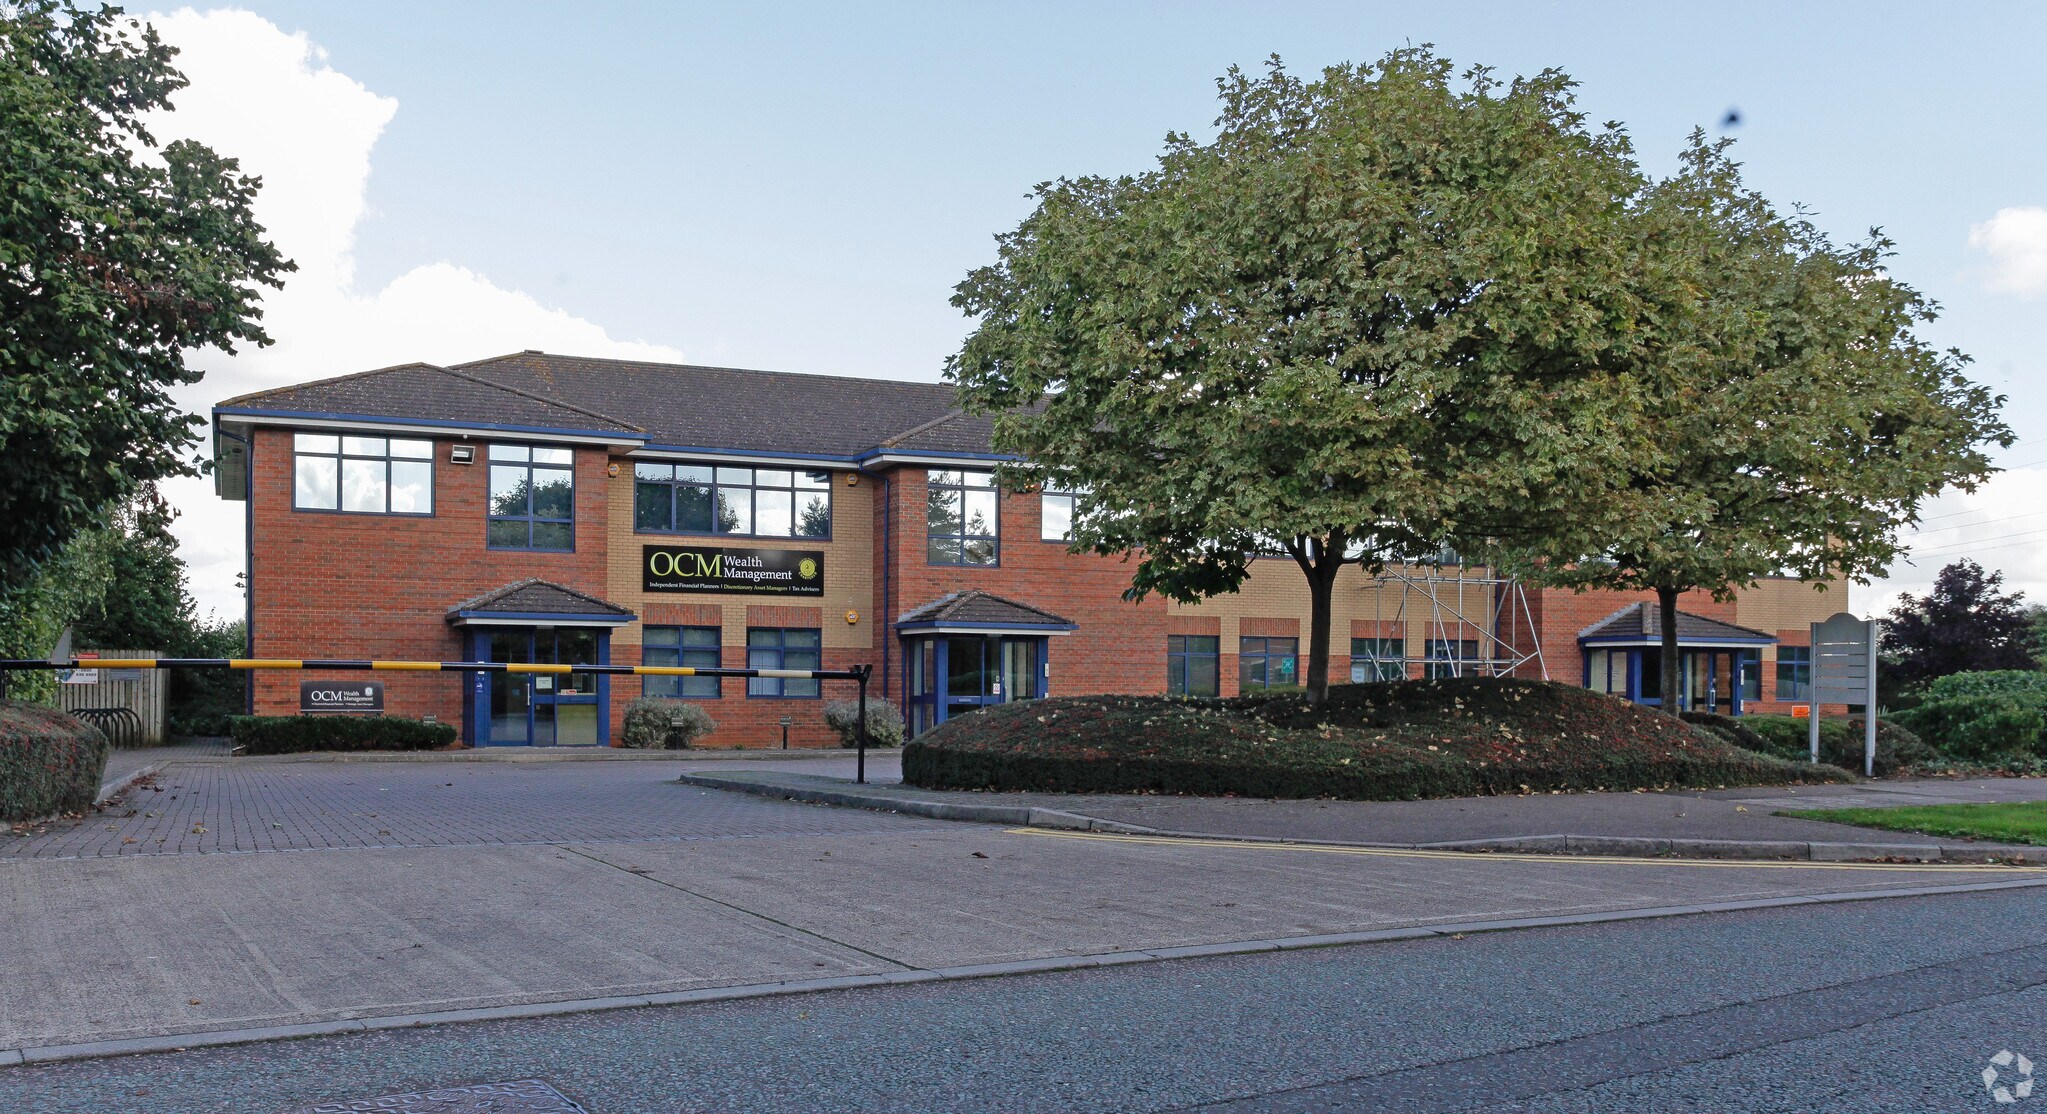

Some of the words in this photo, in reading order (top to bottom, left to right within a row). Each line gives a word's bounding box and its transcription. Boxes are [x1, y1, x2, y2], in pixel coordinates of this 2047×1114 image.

[650, 551, 722, 577] OCM
[724, 556, 762, 567] Wealth
[724, 568, 792, 582] Management
[649, 581, 678, 589] Independent
[311, 691, 342, 701] OCM
